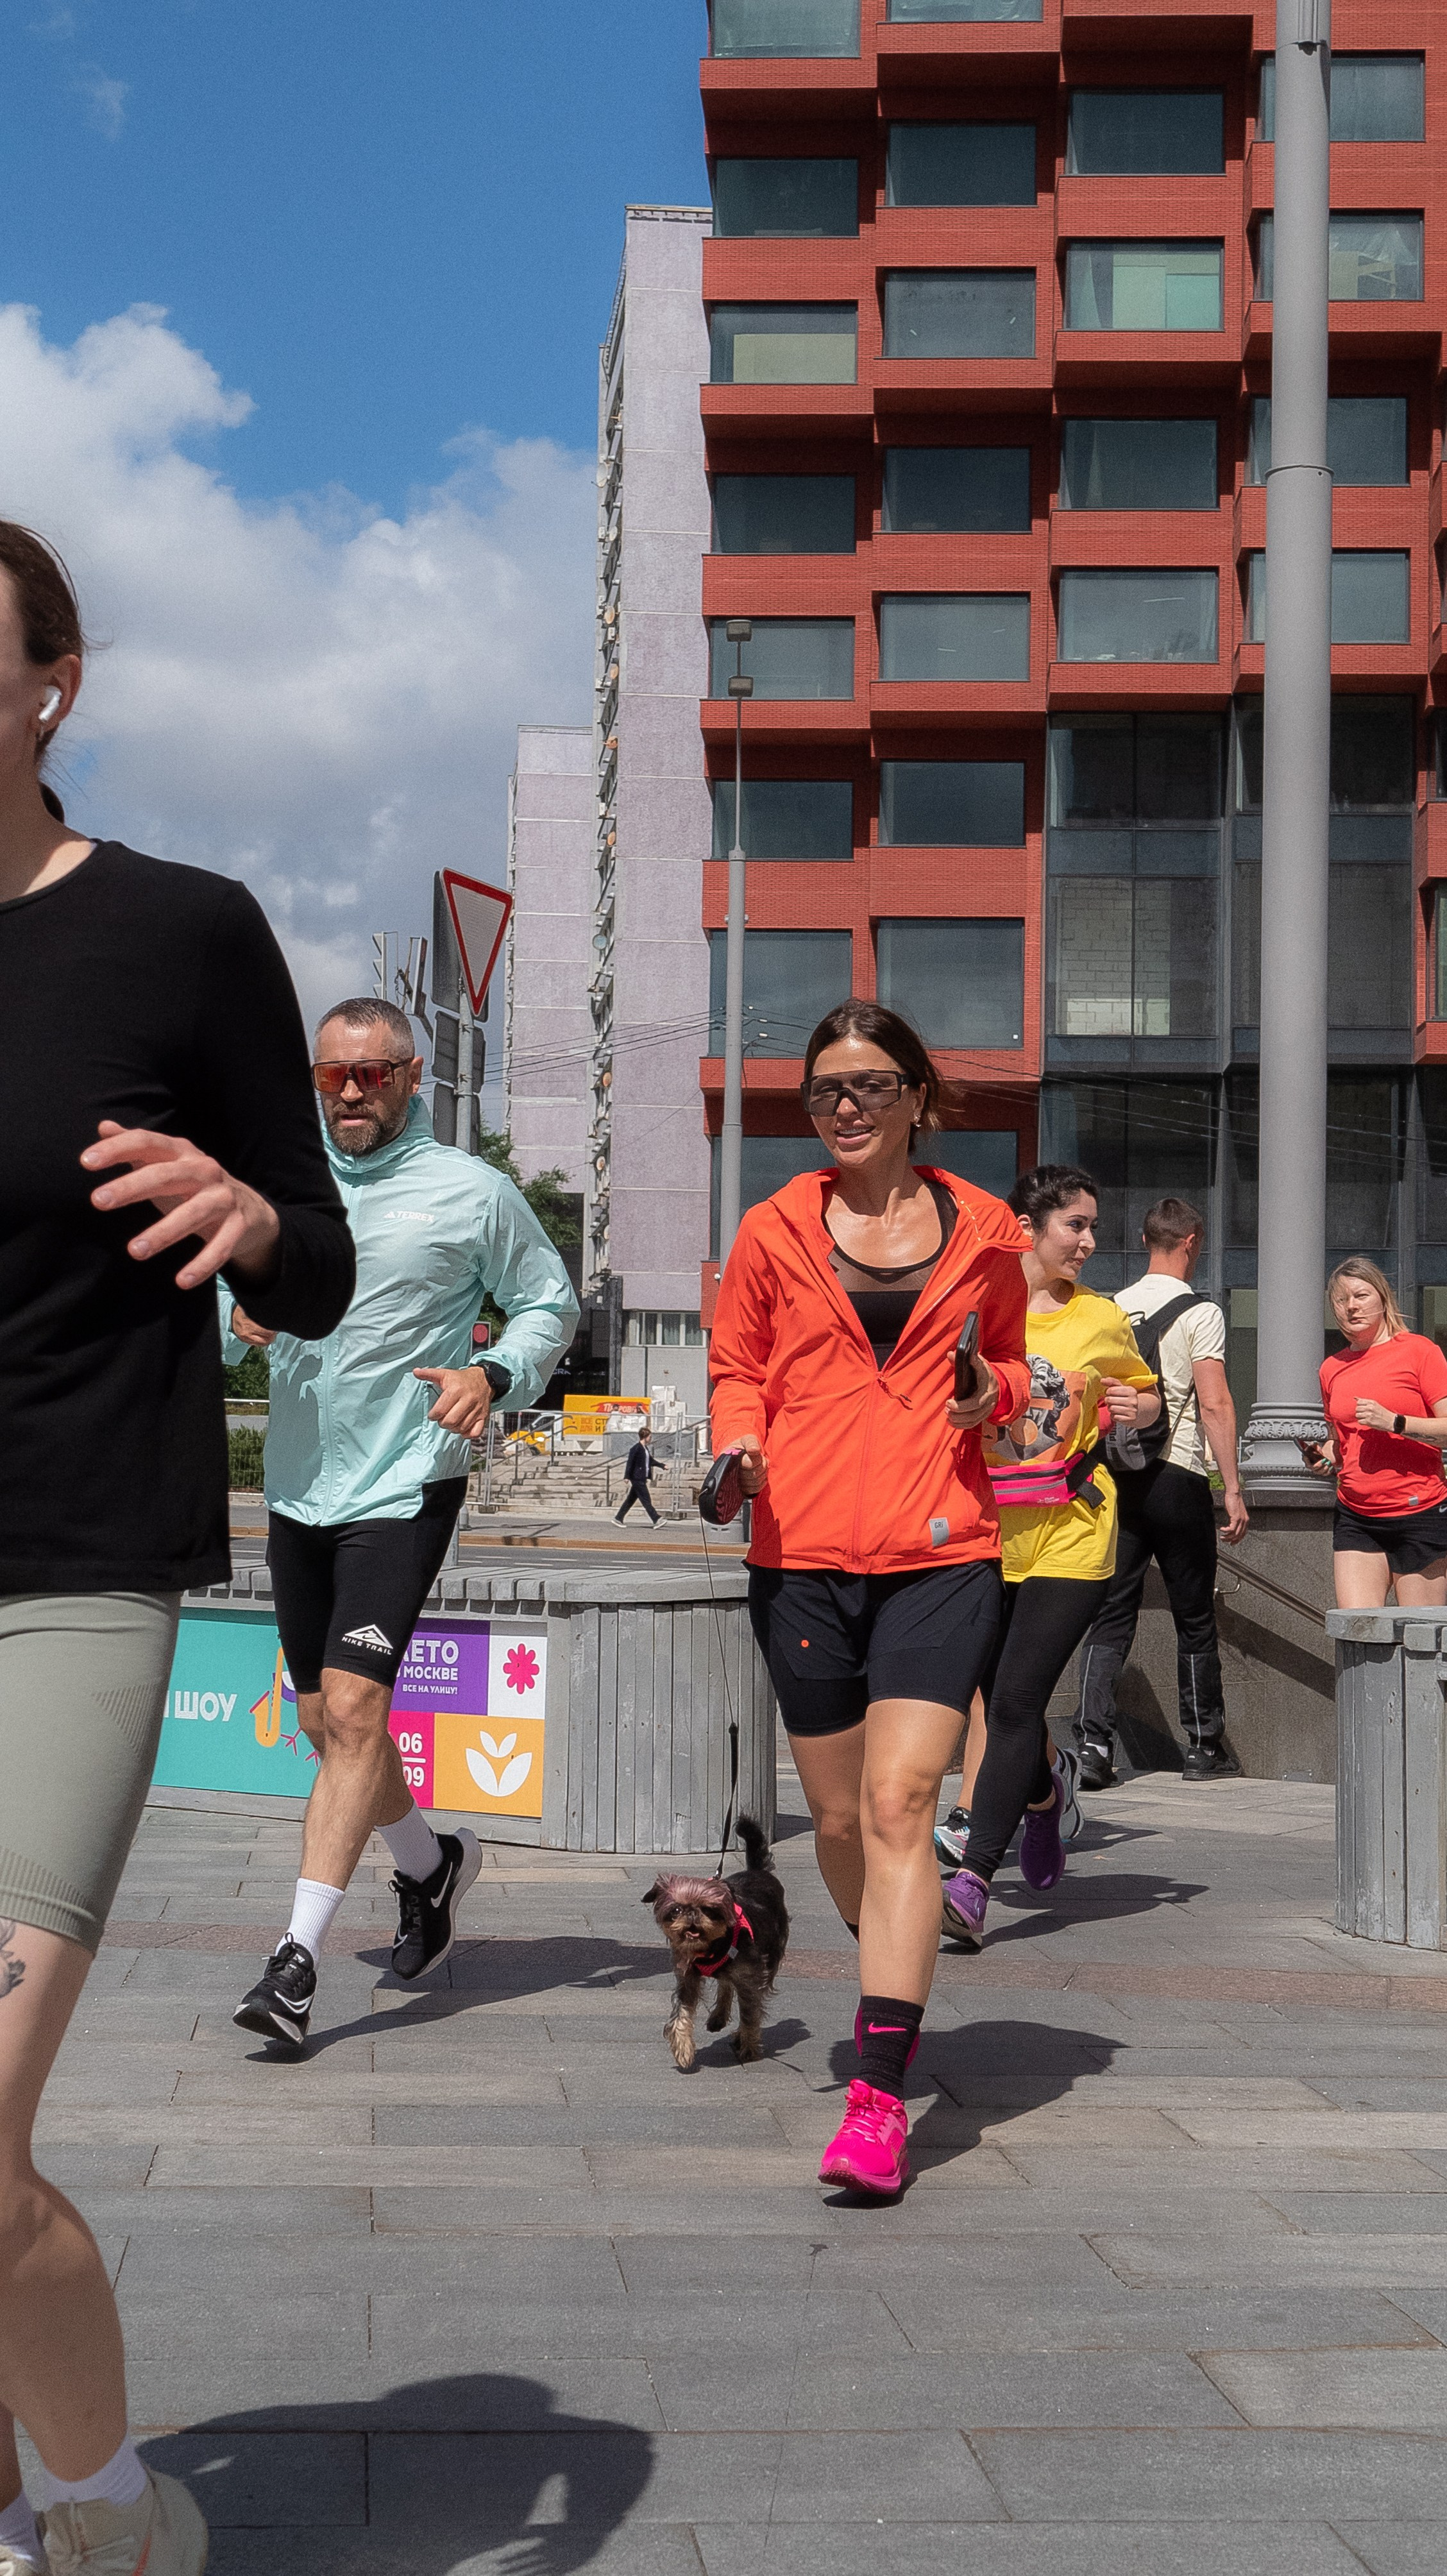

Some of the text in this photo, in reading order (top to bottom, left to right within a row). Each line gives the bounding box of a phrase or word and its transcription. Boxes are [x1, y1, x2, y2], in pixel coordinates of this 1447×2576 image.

[397, 1210, 435, 1221] TERREX
[341, 1636, 392, 1655] NIKE TRAIL
[403, 1665, 459, 1681] МОСКВЕ
[402, 1684, 458, 1695] ВСЕ НА УЛИЦУ!
[174, 1690, 238, 1722] ШОУ
[398, 1732, 423, 1754] 06
[403, 1765, 425, 1787] 09
